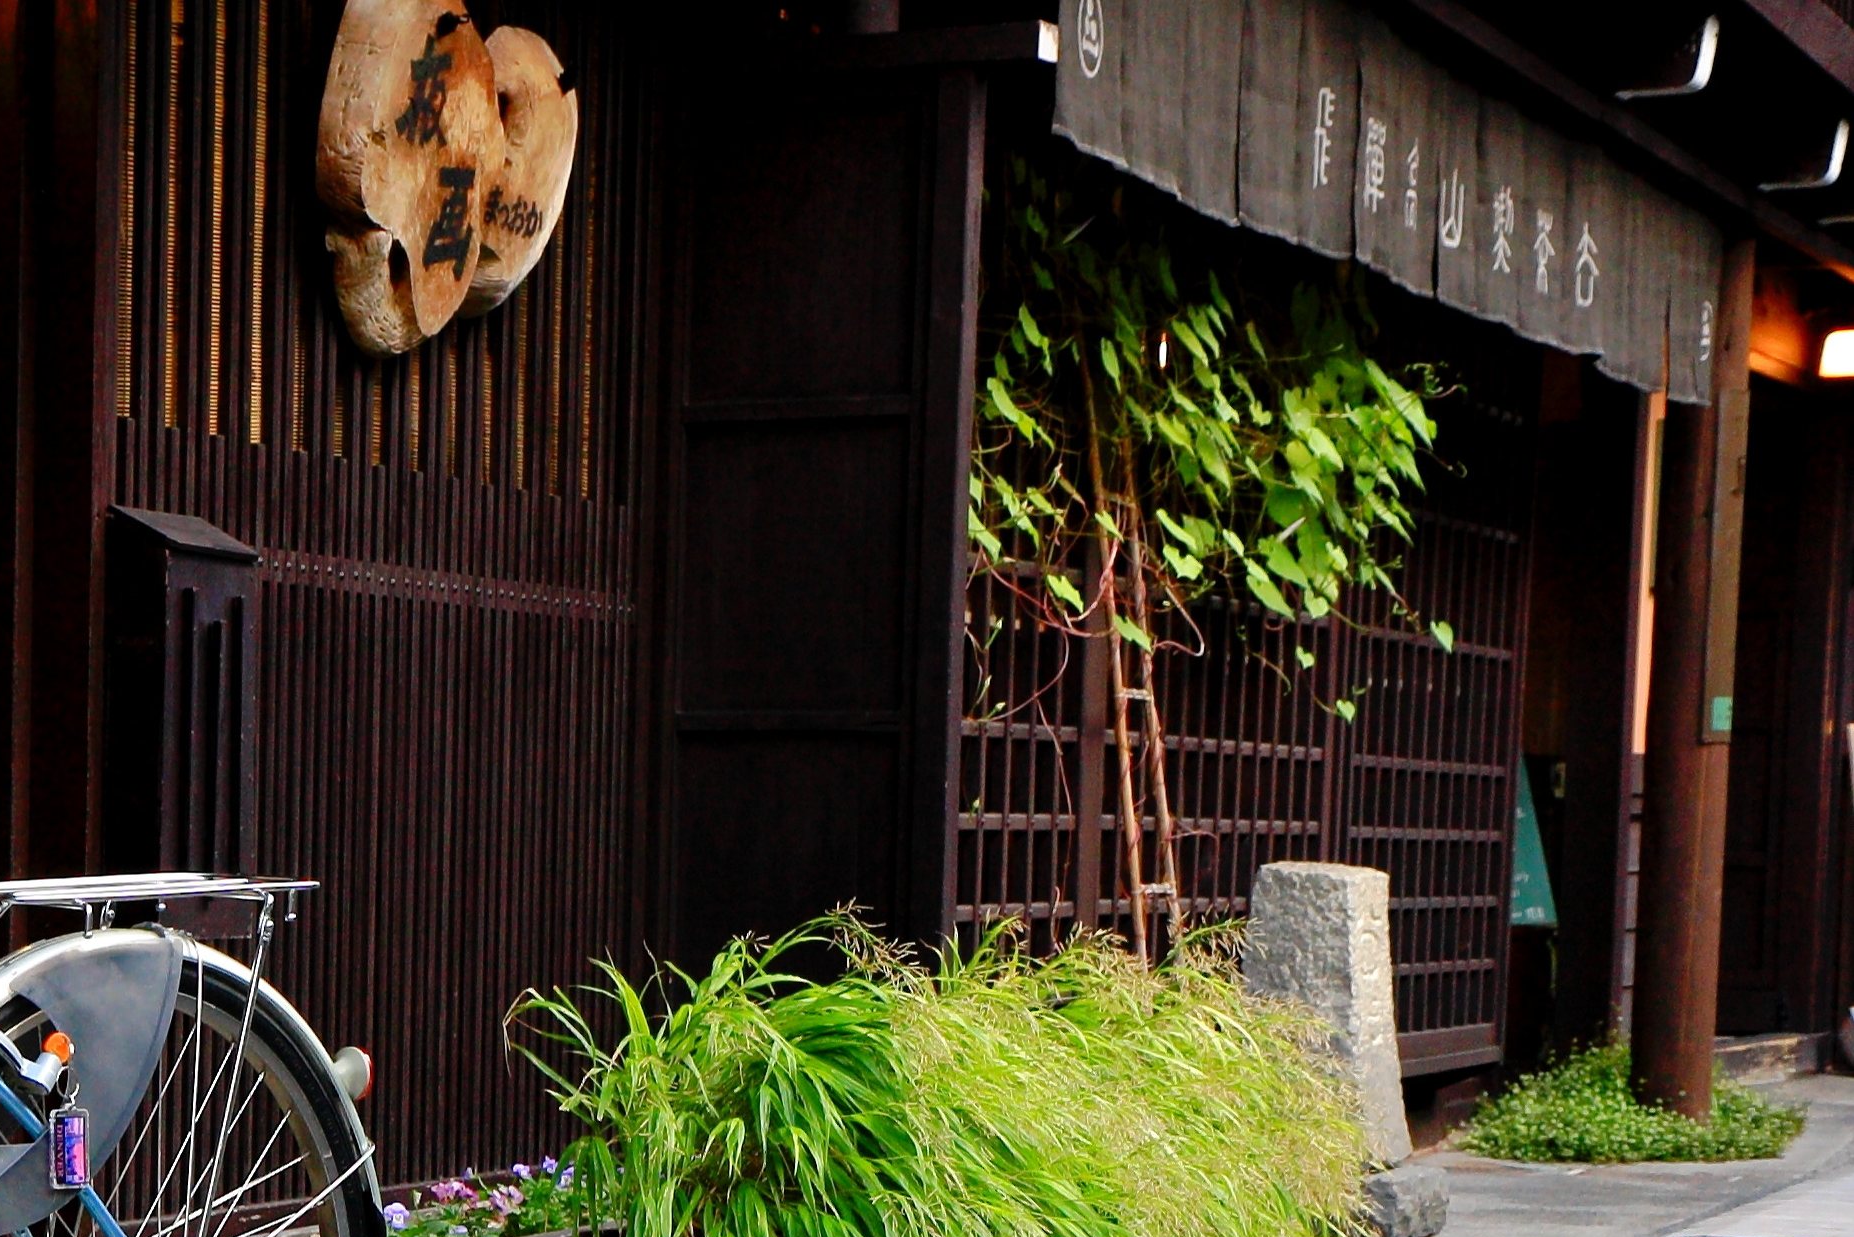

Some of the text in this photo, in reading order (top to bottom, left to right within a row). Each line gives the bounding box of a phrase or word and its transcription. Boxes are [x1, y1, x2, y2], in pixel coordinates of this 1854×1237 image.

[483, 185, 543, 239] まつおか
[56, 1124, 64, 1177] DENVER
